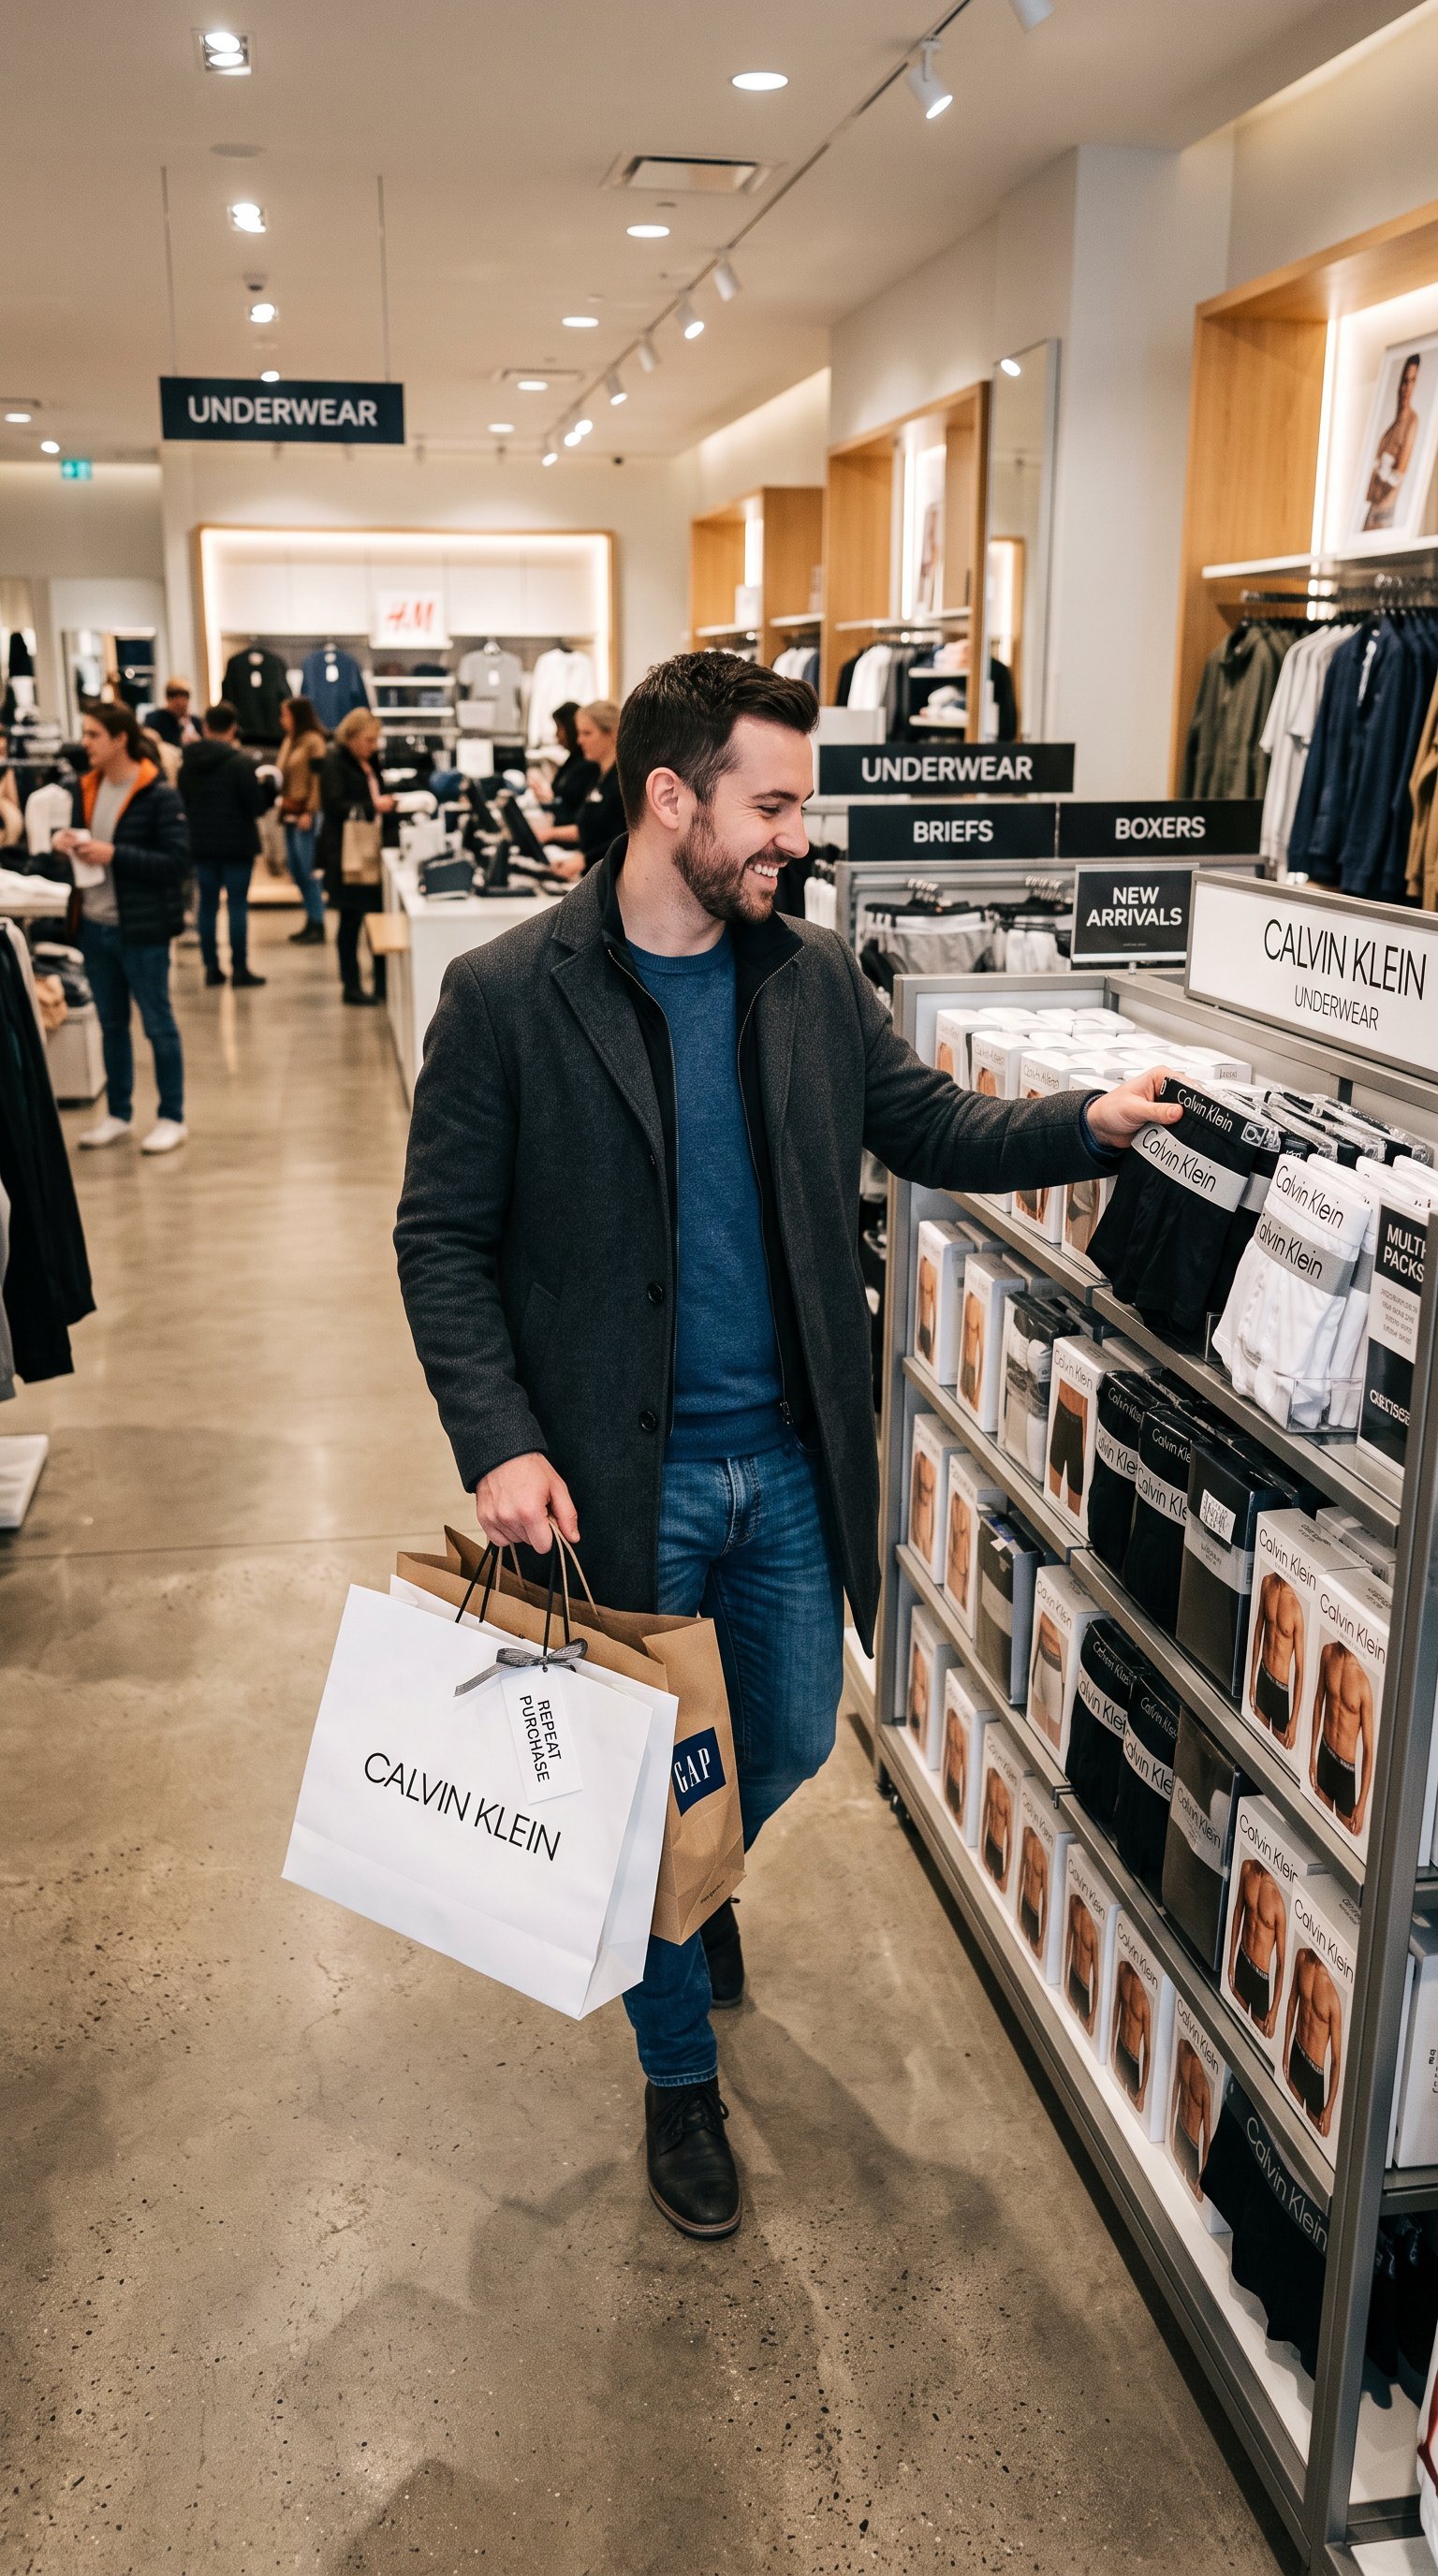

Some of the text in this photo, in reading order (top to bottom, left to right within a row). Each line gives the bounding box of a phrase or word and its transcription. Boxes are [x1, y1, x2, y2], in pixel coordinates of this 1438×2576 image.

[187, 395, 378, 427] UNDERWEAR
[387, 600, 434, 632] HM
[861, 755, 1034, 783] UNDERWEAR
[913, 819, 994, 843] BRIEFS
[1114, 815, 1207, 841] BOXERS
[1085, 907, 1183, 927] ARRIVALS
[1112, 886, 1160, 906] NEW
[1264, 918, 1428, 1001] CALVIN KLEIN
[1294, 985, 1380, 1032] UNDERWEAR
[1177, 1088, 1234, 1134] Calvin Klein
[1141, 1128, 1217, 1193] Calvin Klein
[1275, 1164, 1345, 1229] Calvin Klein
[1257, 1213, 1324, 1280] alvin Klein
[1383, 1245, 1425, 1283] PACKS
[1259, 1529, 1289, 1569] Calvin
[1289, 1553, 1317, 1592] Klein
[1319, 1592, 1356, 1634] Calvin
[1356, 1622, 1387, 1665] Klein
[519, 1694, 550, 1783] PURCHASE
[536, 1699, 563, 1761] REPEAT
[673, 1747, 712, 1794] GAP
[364, 1752, 562, 1862] CALVIN KLEIN
[1239, 1814, 1272, 1862] Calvin
[1294, 1898, 1327, 1953] Calvin
[1326, 1936, 1356, 1985] Klein
[1247, 2117, 1328, 2252] Calvin Klein
